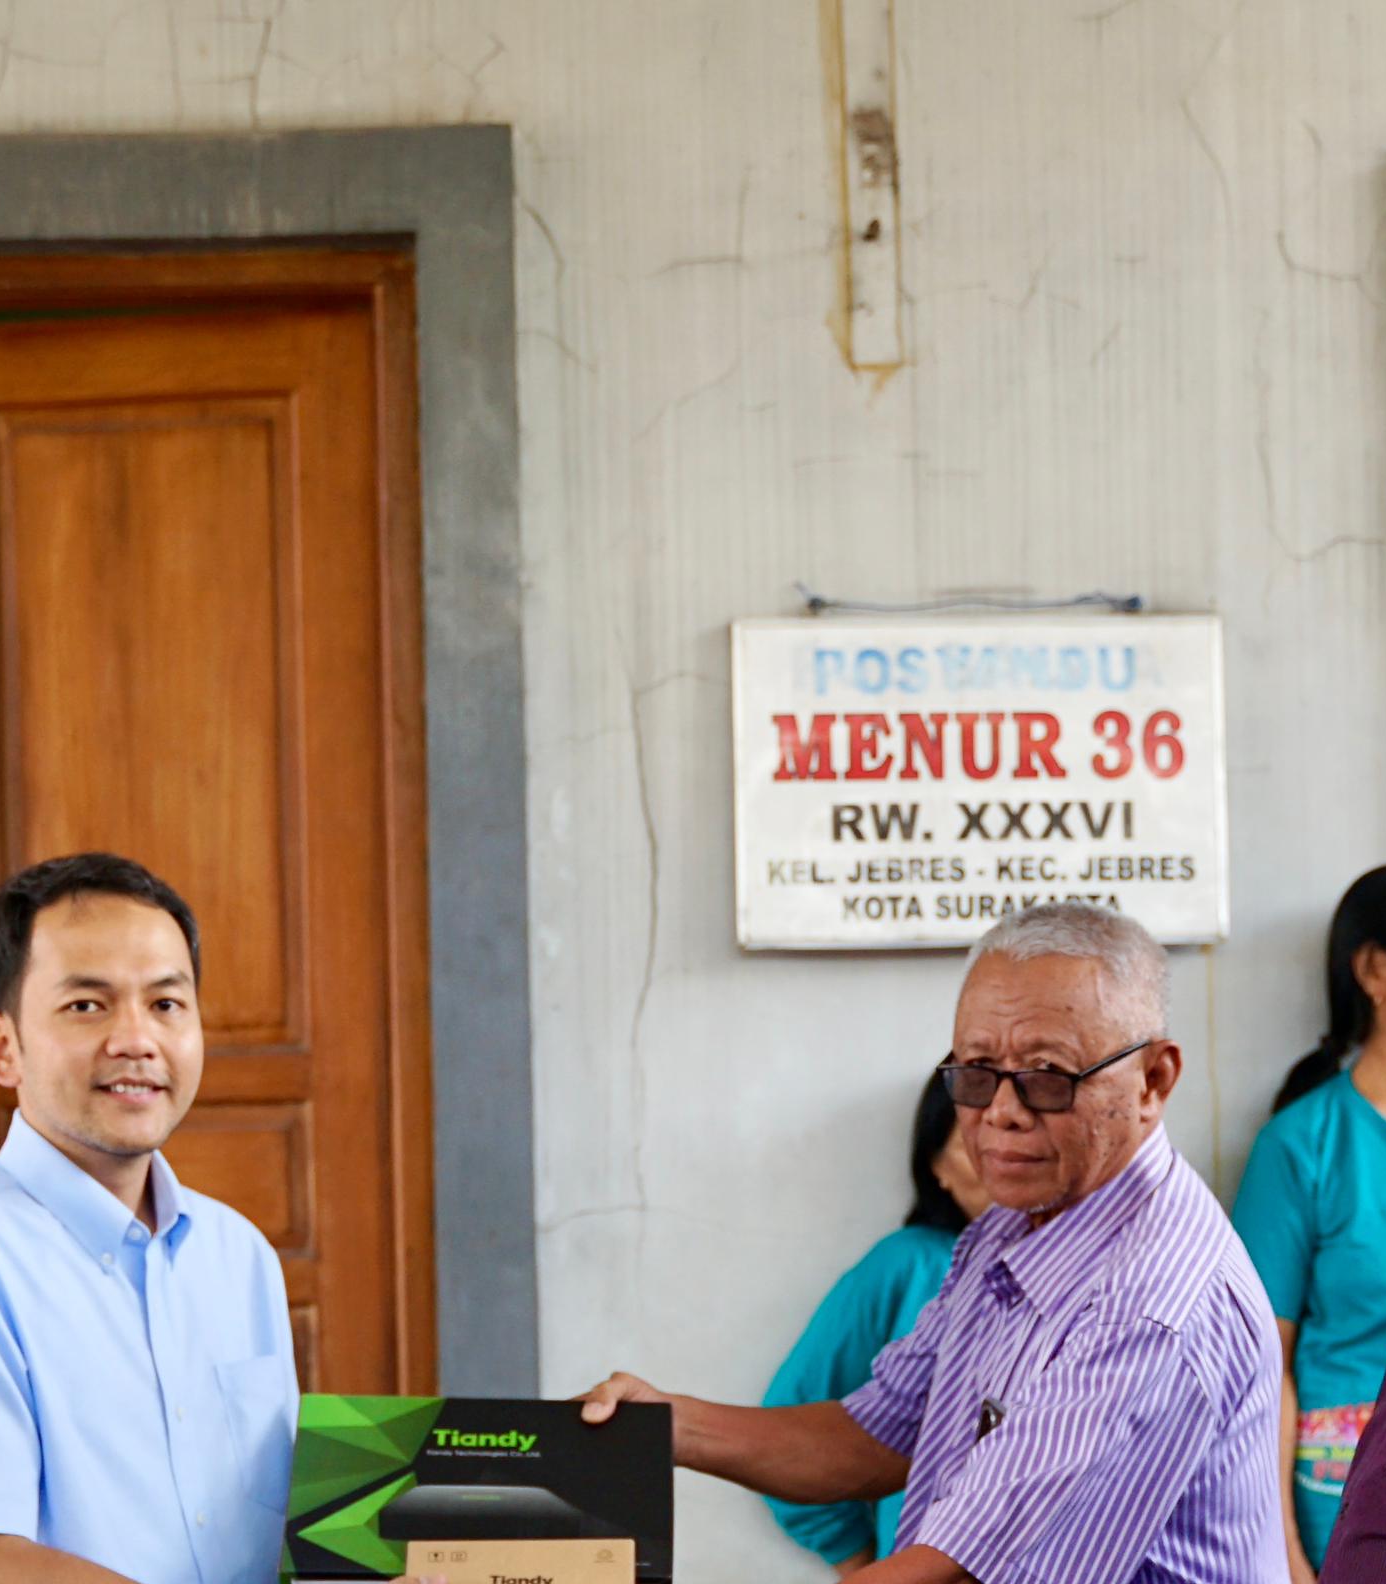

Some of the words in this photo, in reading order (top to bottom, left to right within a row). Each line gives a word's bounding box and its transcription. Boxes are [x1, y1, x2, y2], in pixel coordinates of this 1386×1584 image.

[772, 711, 1067, 782] MENUR
[1092, 710, 1184, 780] 36
[831, 803, 932, 841] RW.
[957, 802, 1134, 840] XXXVI
[766, 858, 835, 885] KEL.
[848, 857, 966, 882] JEBRES
[997, 857, 1066, 882] KEC.
[1079, 856, 1195, 881] JEBRES
[843, 896, 923, 920] KOTA
[433, 1429, 537, 1452] Tiandy
